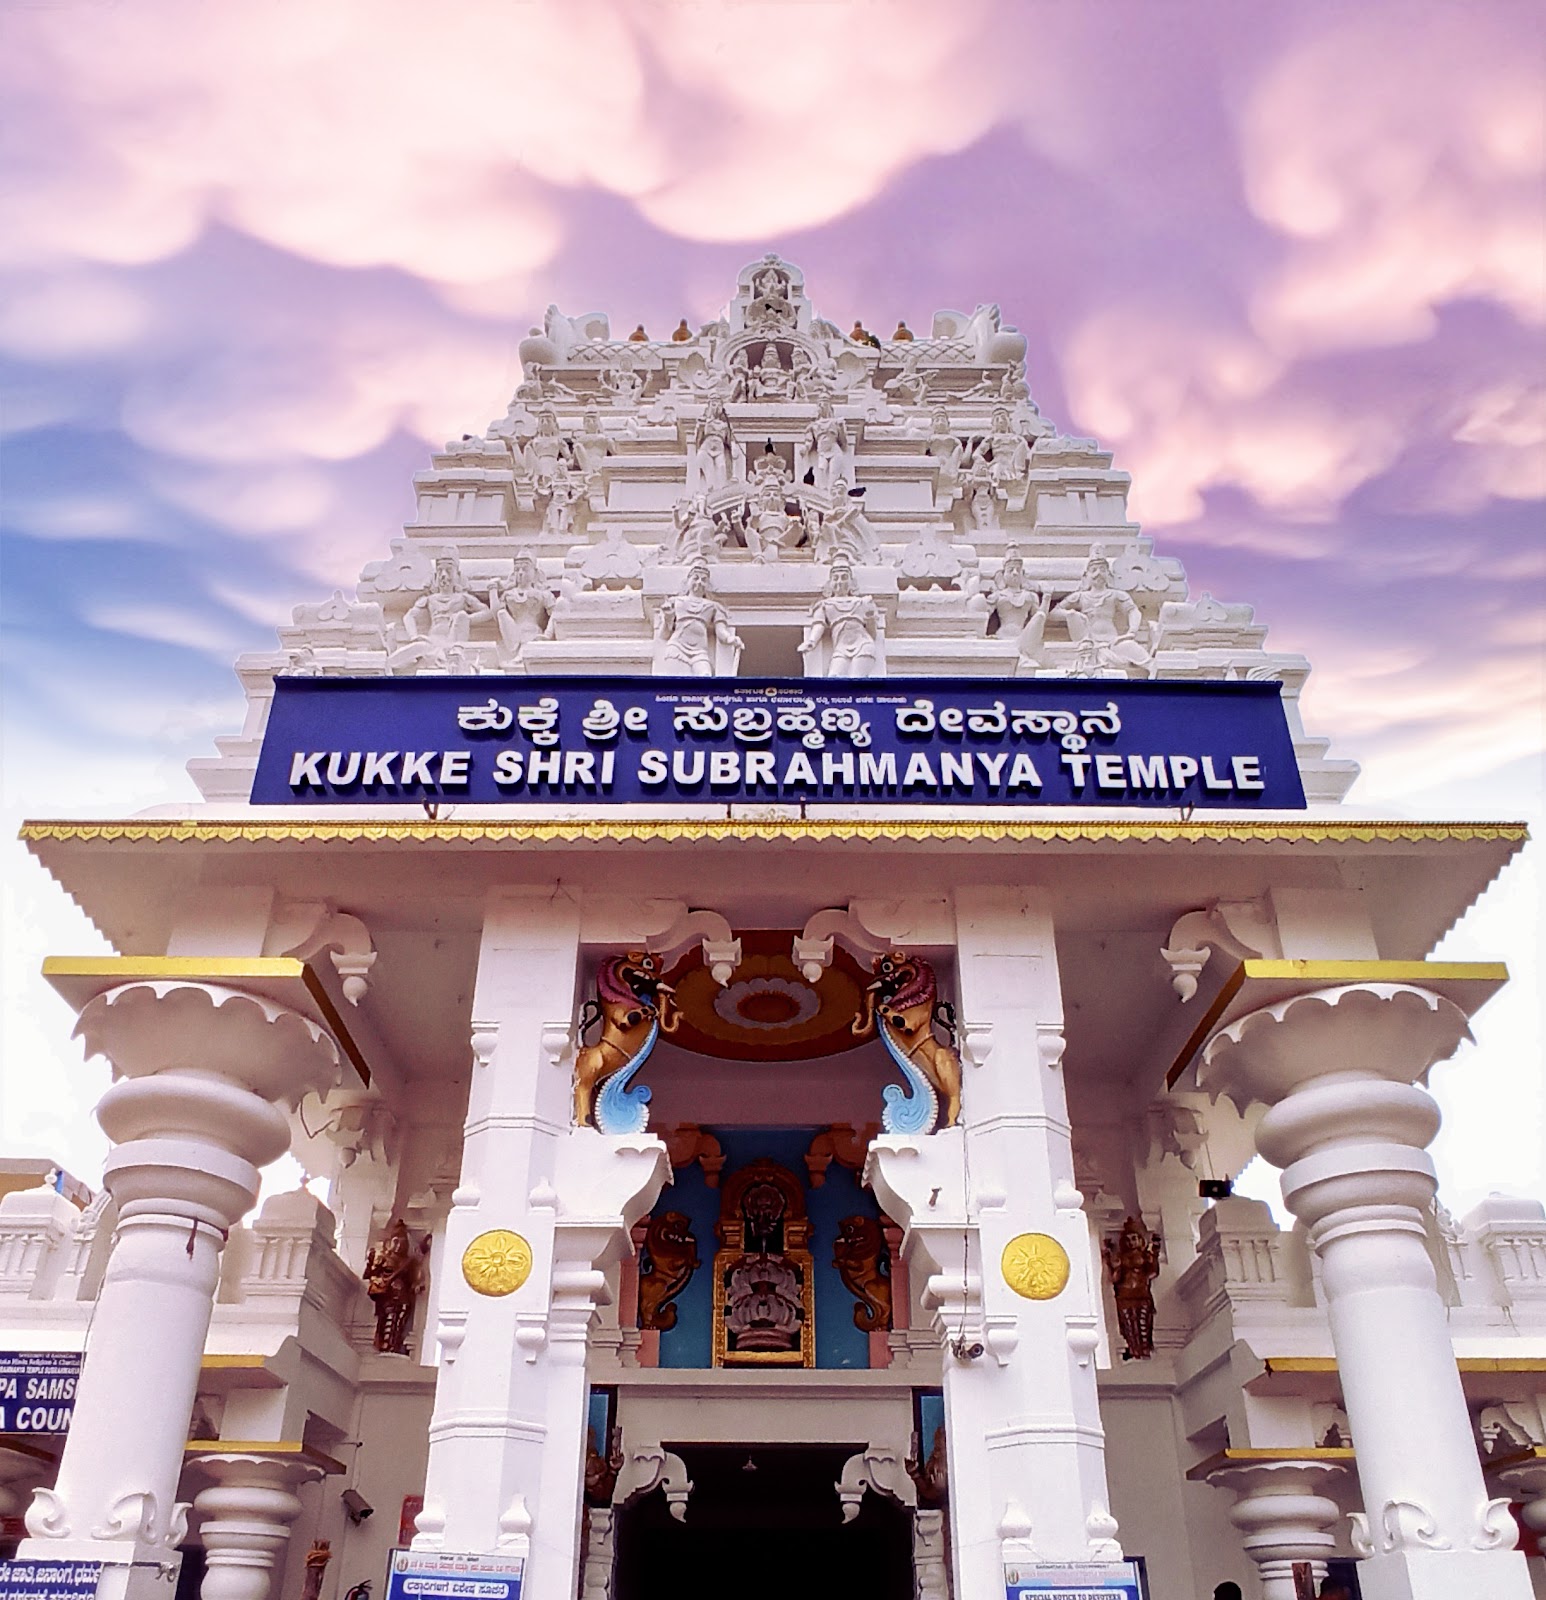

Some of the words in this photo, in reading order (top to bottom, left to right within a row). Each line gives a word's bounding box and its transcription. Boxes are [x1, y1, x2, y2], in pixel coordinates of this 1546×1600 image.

[457, 697, 560, 746] ಕುಕ್ಕೆ
[582, 699, 649, 740] ಶ್ರೀ
[673, 697, 873, 750] ಸುಬ್ರಹ್ಮಣ್ಯ
[895, 699, 1122, 753] ದೇವಸ್ಥಾನ
[289, 751, 471, 786] KUKKE
[493, 750, 616, 785] SHRI
[637, 750, 1043, 787] SUBRAHMANYA
[1061, 754, 1265, 790] TEMPLE
